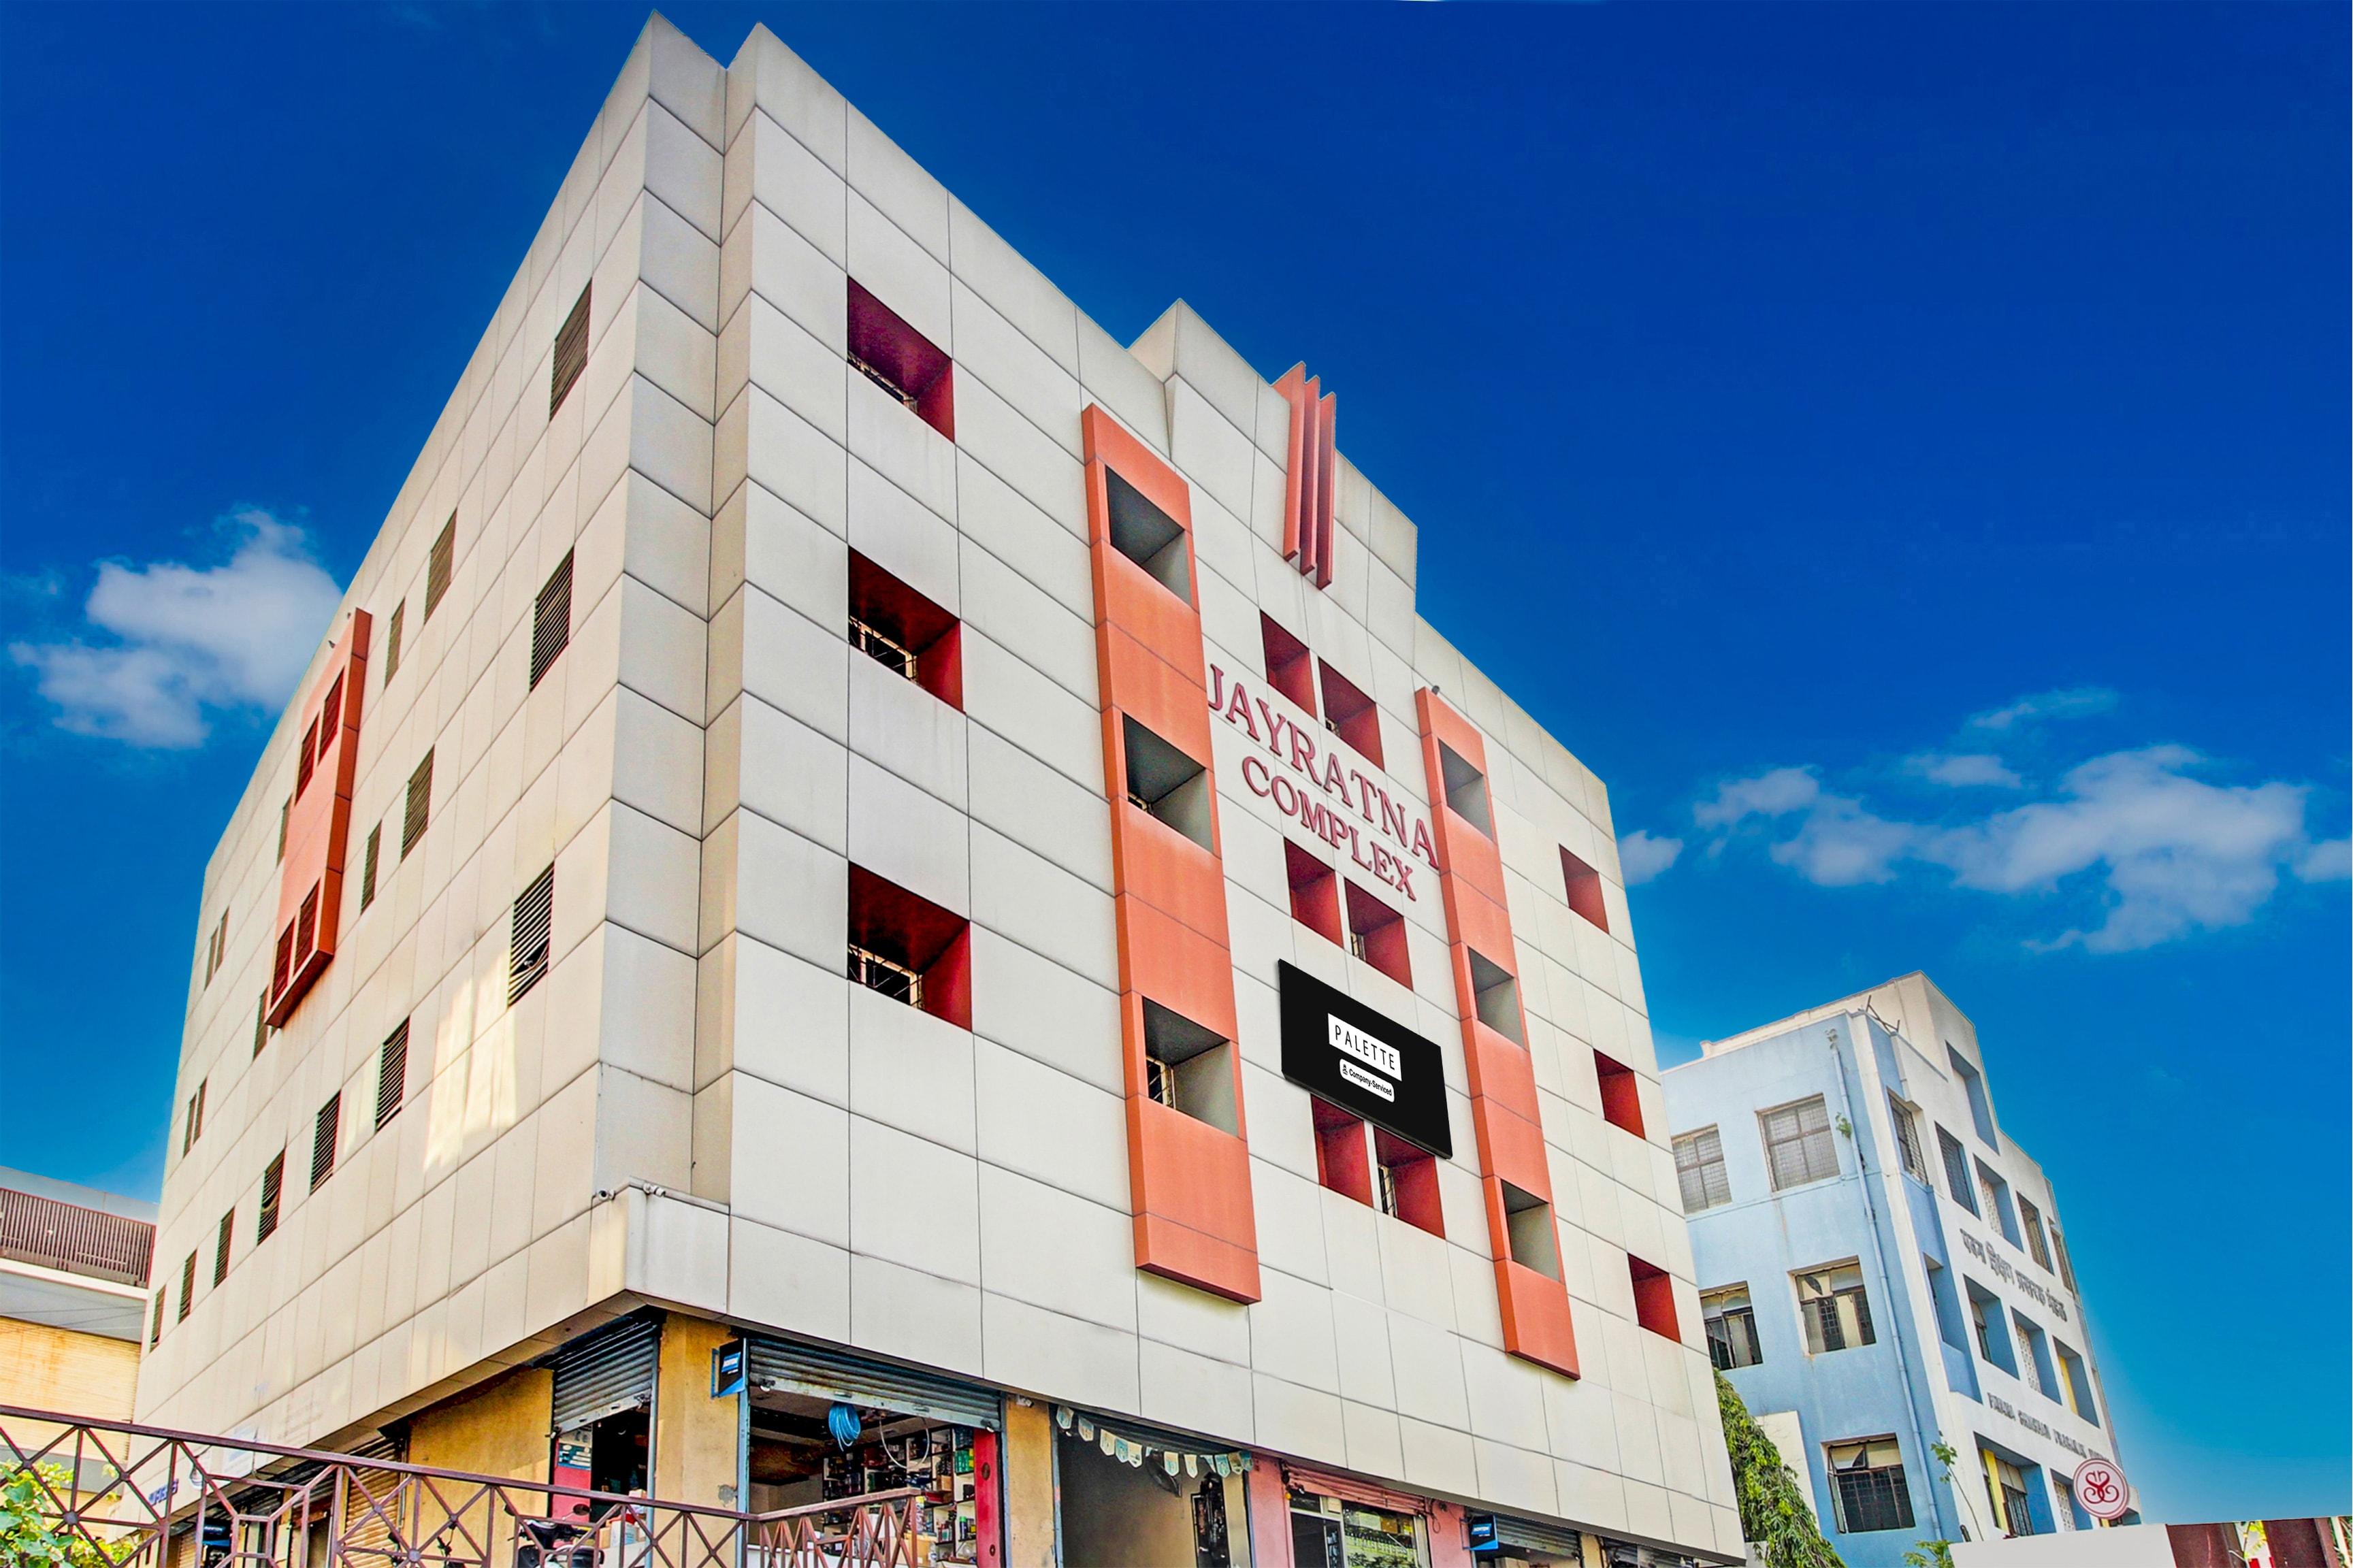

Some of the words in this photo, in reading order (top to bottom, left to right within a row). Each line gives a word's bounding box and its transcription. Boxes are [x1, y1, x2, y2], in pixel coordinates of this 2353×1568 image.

[1208, 663, 1440, 870] JAYRATNA
[1242, 755, 1416, 902] COMPLEX
[1335, 1025, 1395, 1071] PALETTE
[1349, 1068, 1393, 1096] Company-Serviced
